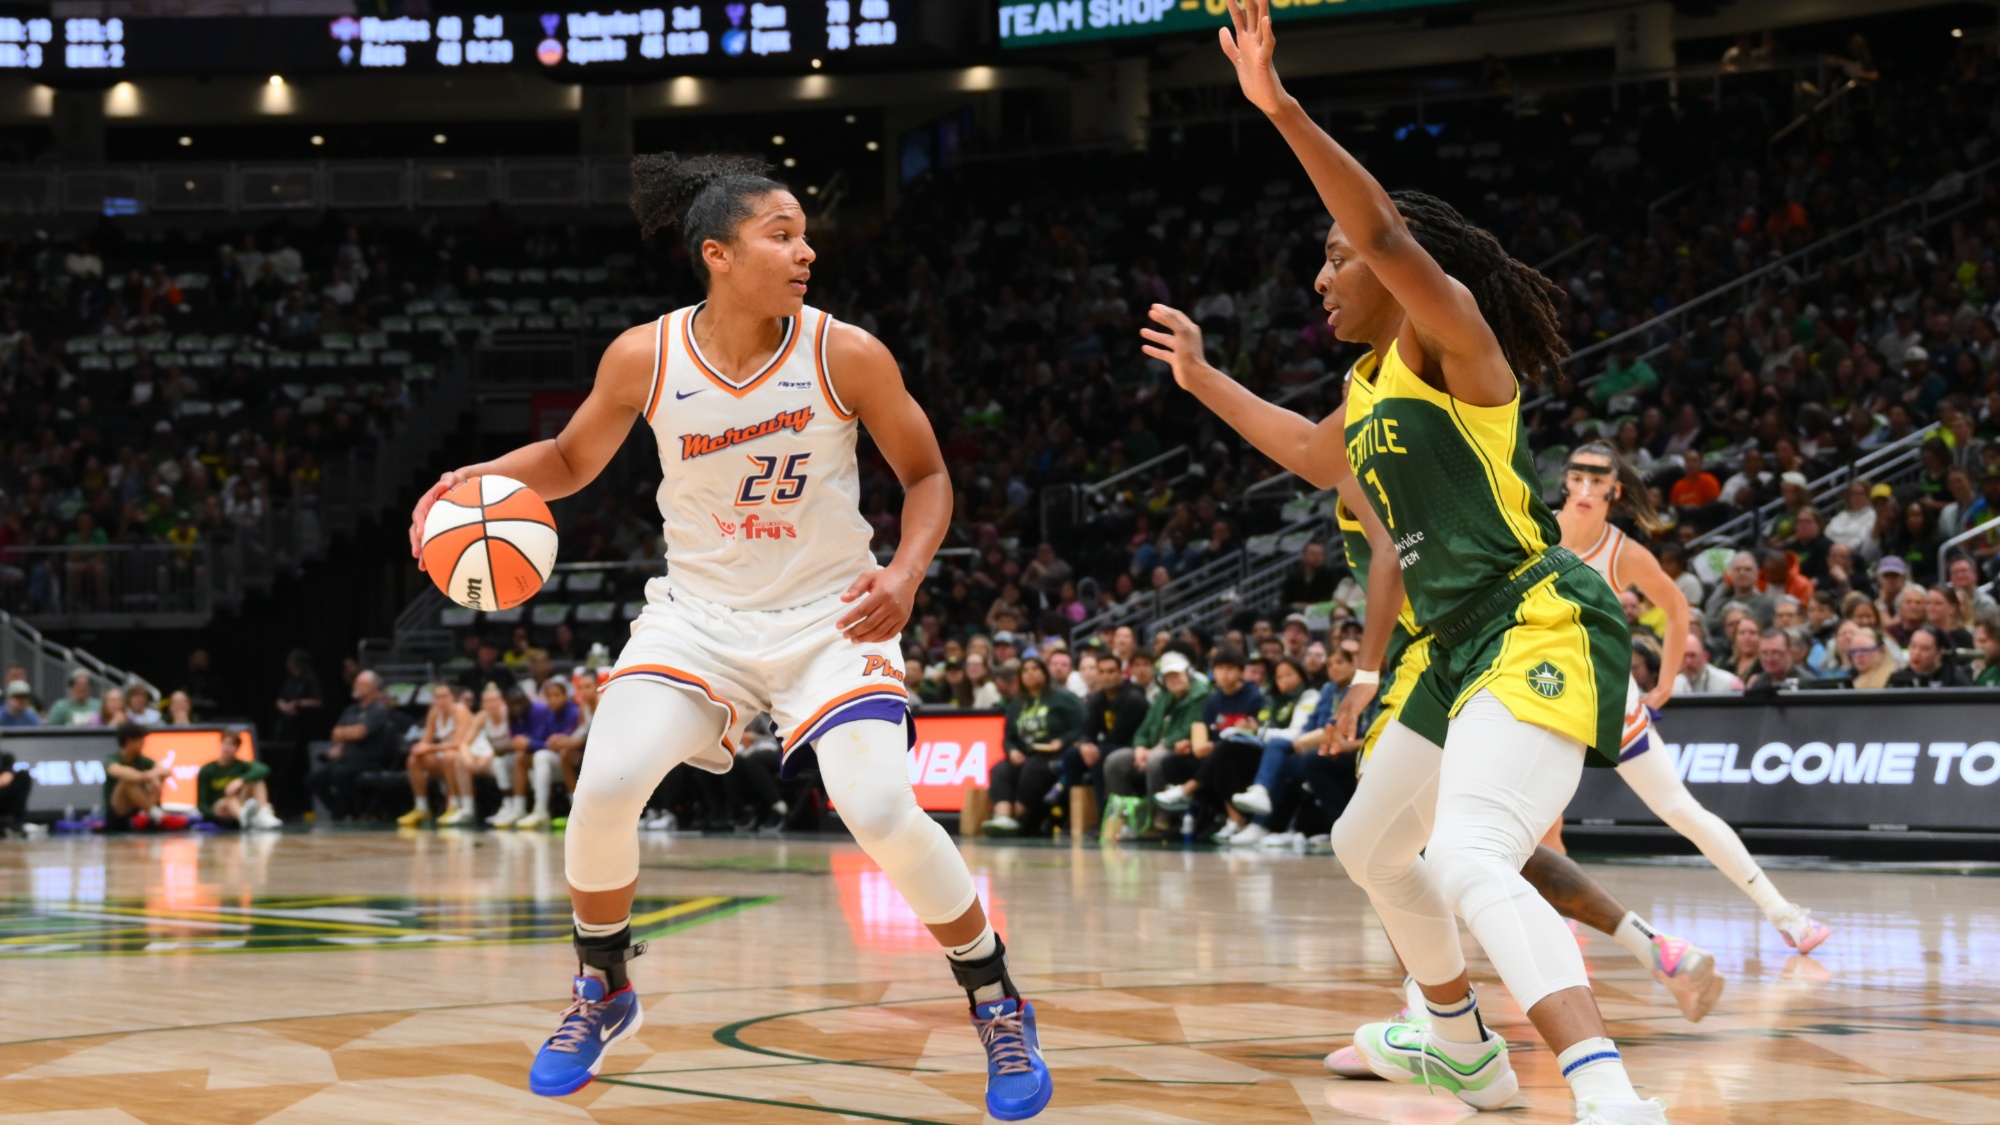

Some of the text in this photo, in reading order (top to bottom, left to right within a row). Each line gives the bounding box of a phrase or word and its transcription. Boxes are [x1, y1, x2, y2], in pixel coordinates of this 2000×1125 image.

[999, 0, 1083, 38] TEAM
[1088, 0, 1176, 28] SHOP
[679, 405, 815, 461] Mercury
[1346, 418, 1407, 476] EATTLE
[734, 452, 812, 507] 25
[1927, 741, 2000, 786] TO
